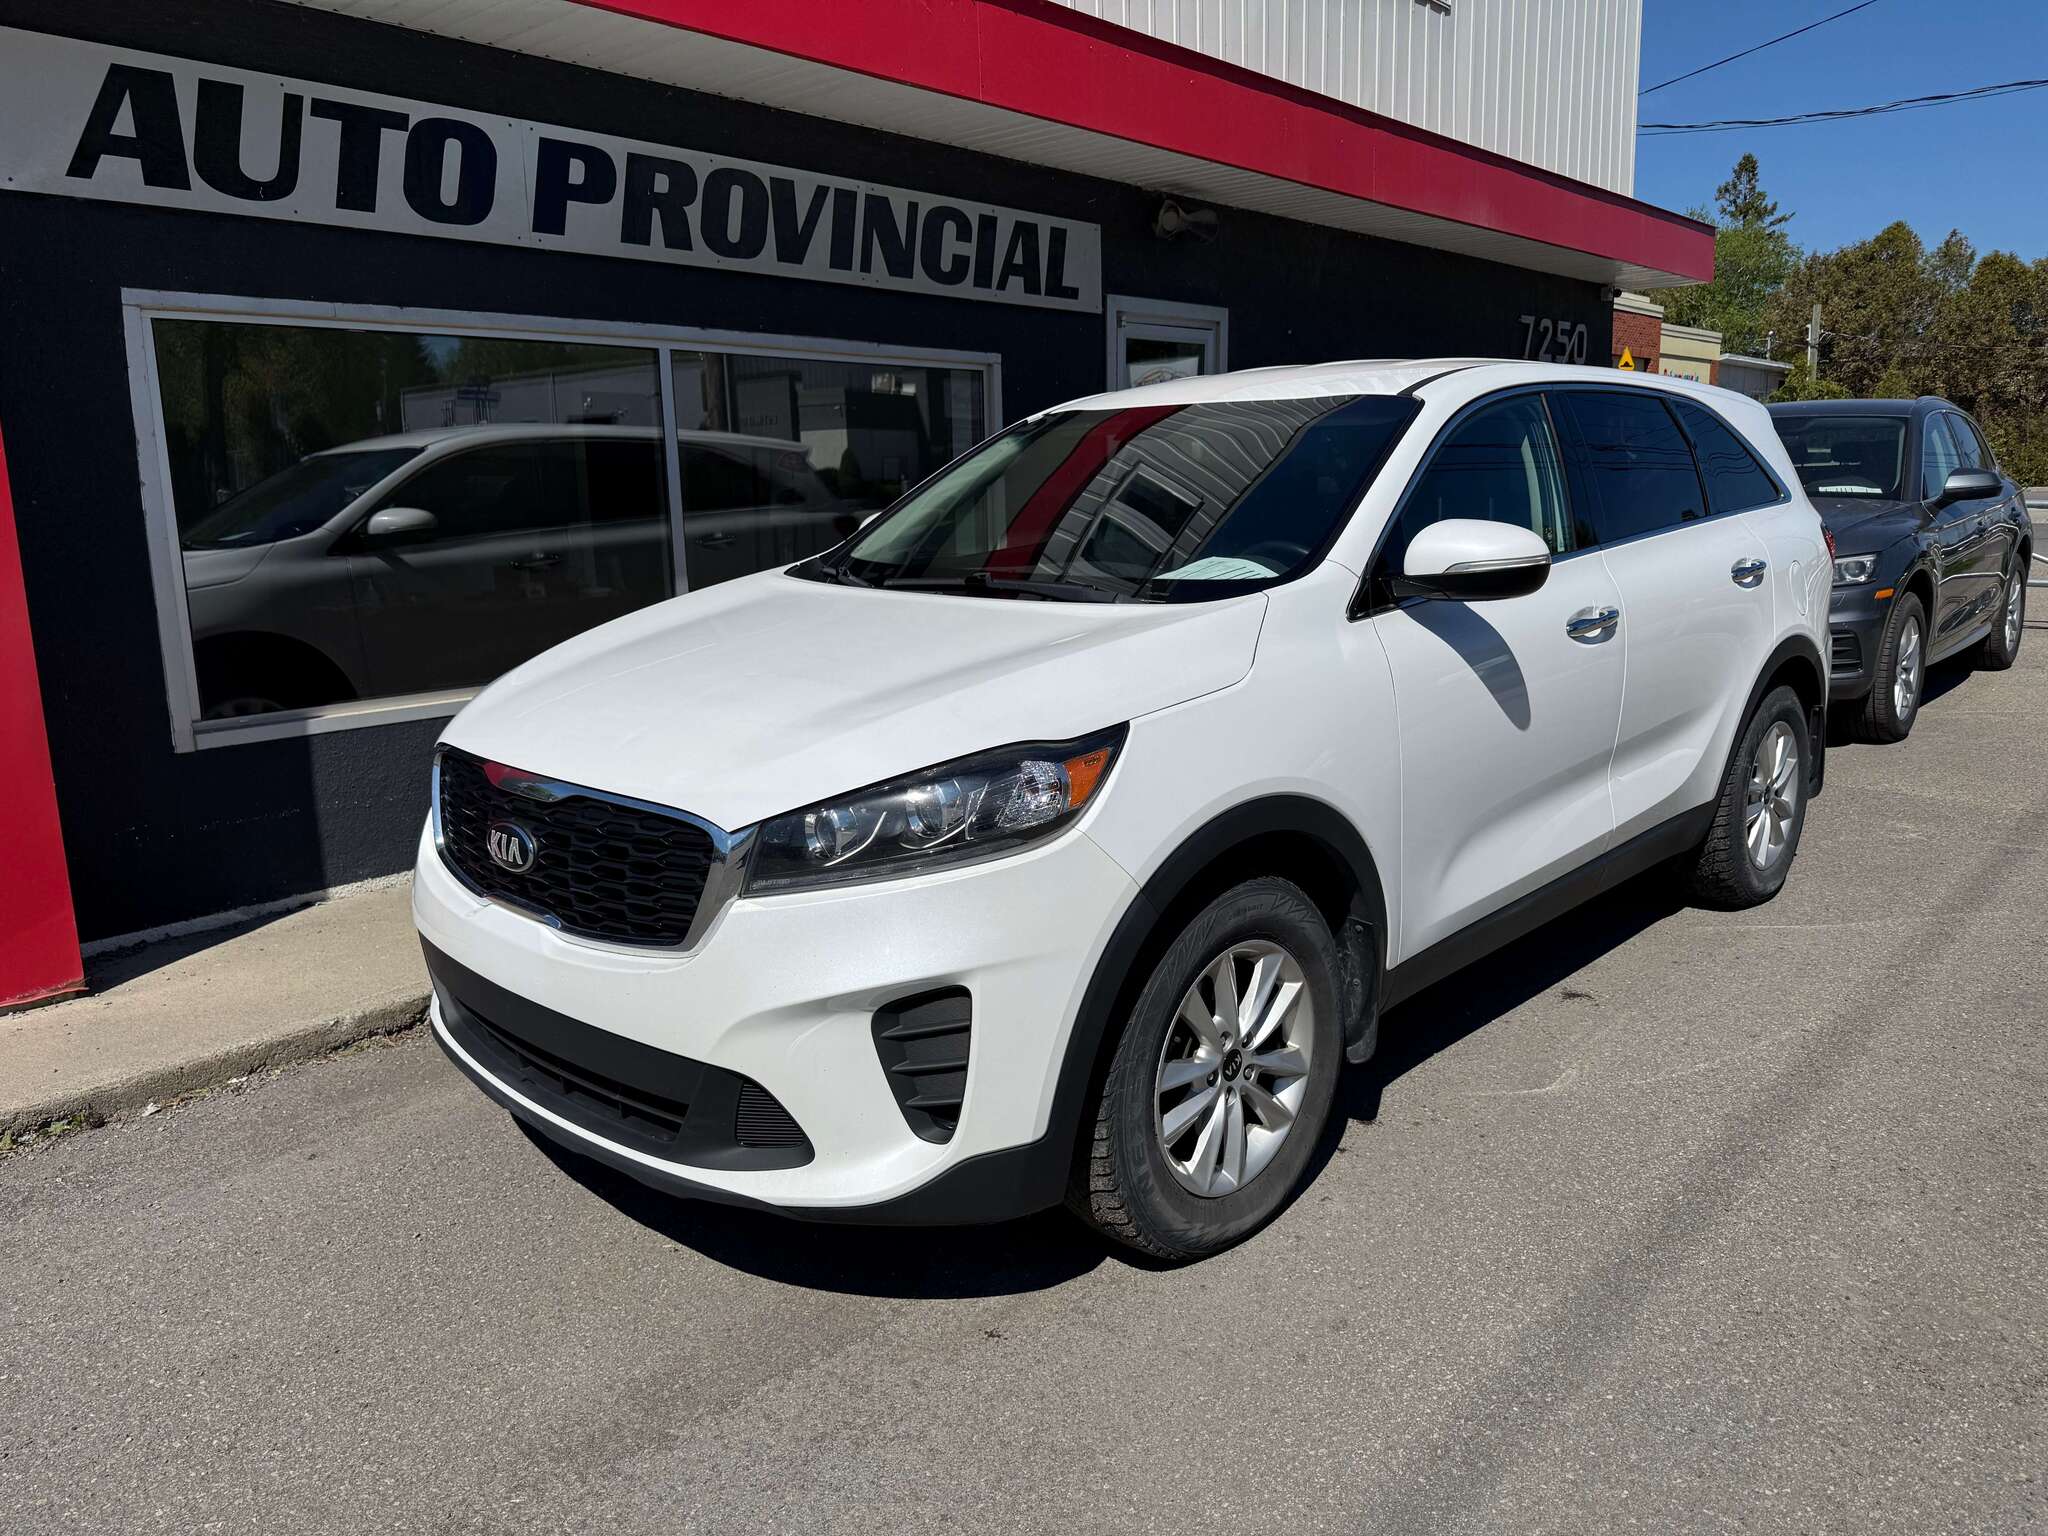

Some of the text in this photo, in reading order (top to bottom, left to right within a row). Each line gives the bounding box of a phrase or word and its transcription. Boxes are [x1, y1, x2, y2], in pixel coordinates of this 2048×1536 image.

[65, 62, 1080, 300] AUTO PROVINCIAL
[1519, 314, 1588, 365] 7250
[490, 829, 524, 865] KIA
[1225, 1054, 1242, 1076] KIA
